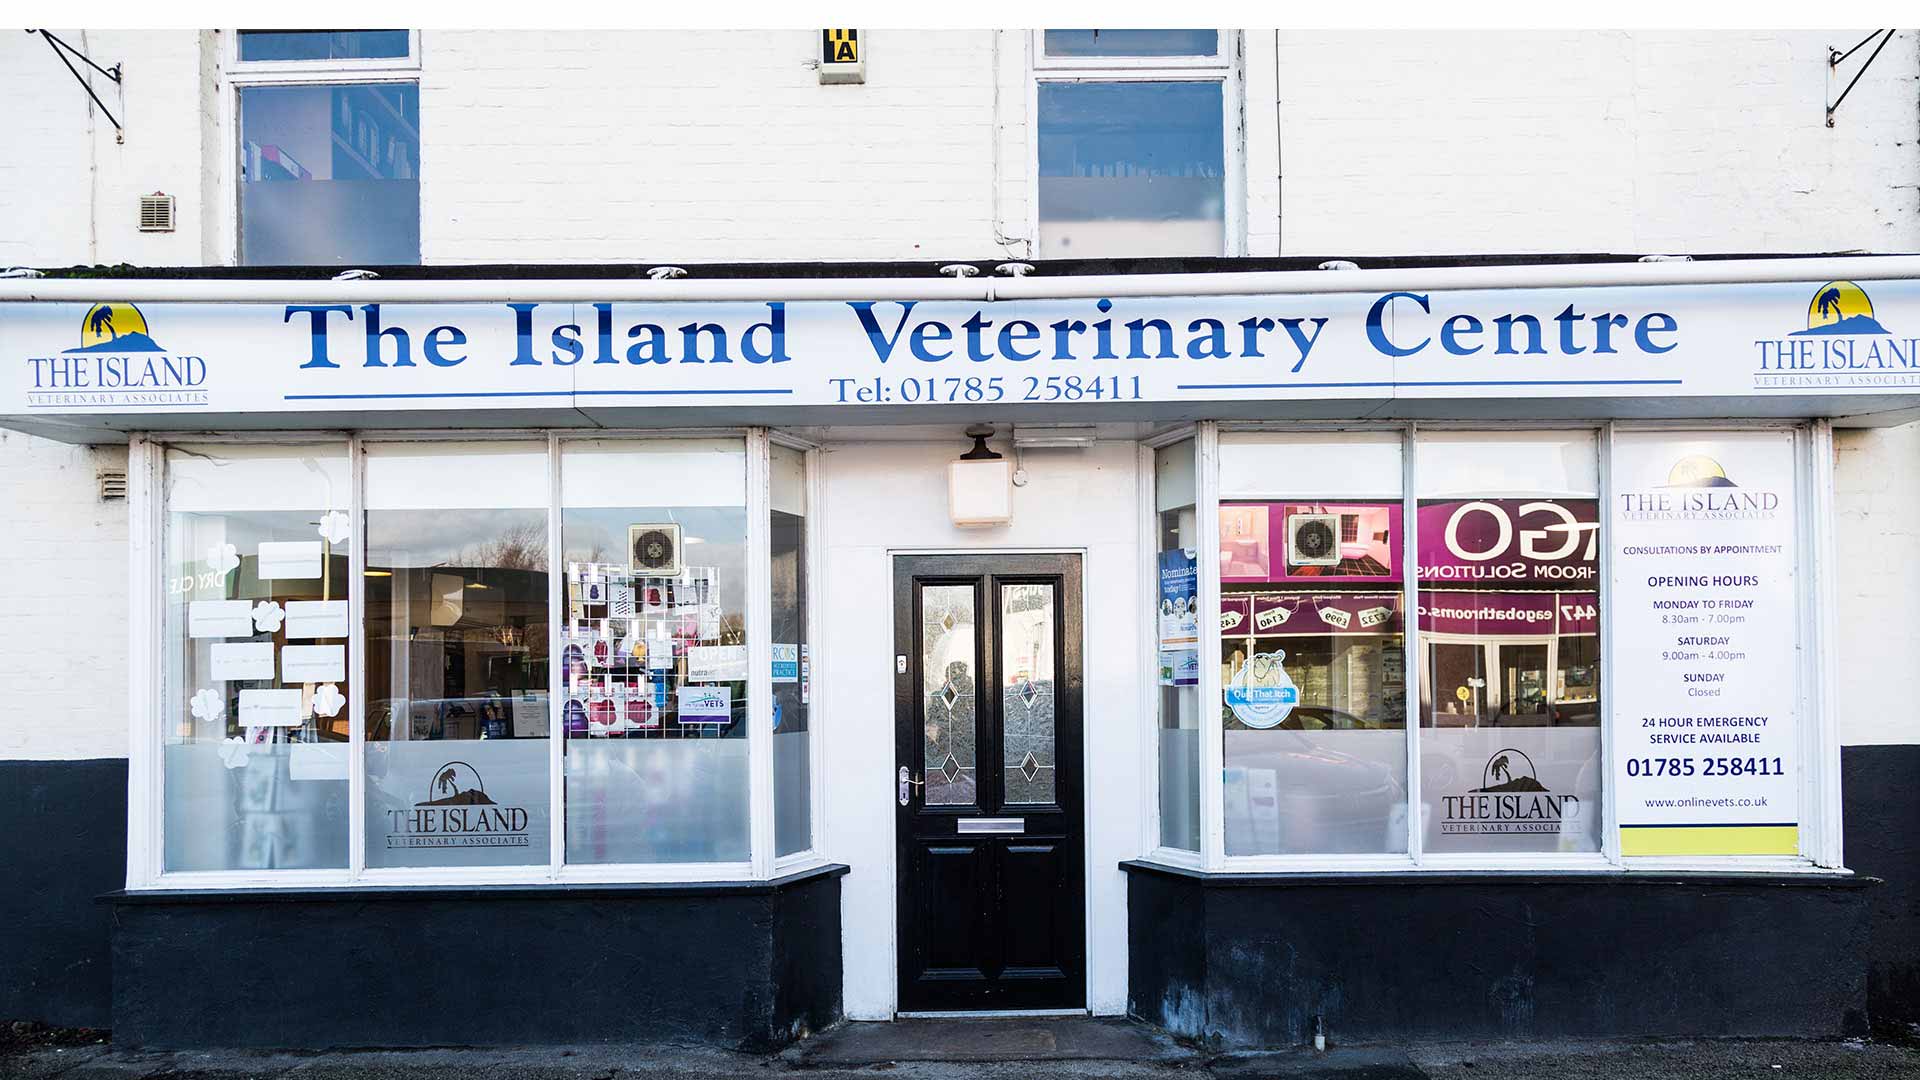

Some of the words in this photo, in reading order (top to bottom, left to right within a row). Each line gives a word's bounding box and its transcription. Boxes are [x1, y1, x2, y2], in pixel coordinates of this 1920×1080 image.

[284, 303, 468, 369] The
[506, 301, 792, 367] Island
[846, 298, 1329, 373] Veterinary
[1366, 292, 1679, 357] Centre
[1754, 340, 1816, 370] THE
[27, 358, 90, 388] THE
[96, 356, 207, 388] ISLAND
[1753, 376, 1841, 386] VETERINARY
[829, 378, 891, 403] Tel:
[900, 376, 1005, 402] 01785
[1023, 374, 1143, 400] 258411
[28, 394, 116, 405] VETERINARY
[124, 392, 209, 403] ASSOCIATES
[1621, 493, 1672, 512] THE
[1683, 492, 1779, 512] ISLAND
[1622, 512, 1697, 521] VETERINARY
[1704, 511, 1776, 520] ASSOCIATES
[1623, 546, 1699, 556] CONSULTATIONS
[1700, 546, 1712, 555] BY
[1714, 545, 1783, 555] APPOINTMENT
[1161, 565, 1198, 579] Nominate
[1648, 576, 1709, 588] OPENING
[1713, 575, 1759, 587] HOURS
[1653, 600, 1699, 609] MONDAY
[1702, 600, 1716, 609] TO
[1718, 600, 1754, 609] FRIDAY
[1662, 614, 1699, 624] 8.30am
[1708, 614, 1745, 625] 7.00pm
[1677, 636, 1730, 646] SATURDAY
[1662, 652, 1699, 661] 9.00am
[1708, 651, 1745, 662] 4.00pm
[1683, 674, 1725, 683] SUNDAY
[1688, 688, 1721, 697] Closed
[704, 700, 725, 708] VETS
[1642, 718, 1656, 728] 24
[1659, 718, 1693, 728] HOUR
[1696, 717, 1768, 728] EMERGENCY
[1650, 734, 1696, 744] SERVICE
[1699, 733, 1761, 744] AVAILABLE
[1626, 758, 1695, 777] 01785
[1702, 757, 1785, 776] 258411
[1442, 796, 1490, 820] THE
[1495, 794, 1581, 820] ISLAND
[1645, 796, 1768, 808] www.onlinevets.co.uk
[387, 809, 437, 833] THE
[442, 807, 528, 833] ISLAND
[1442, 824, 1511, 832] VETERINARY
[387, 838, 457, 846] VETERINARY
[463, 836, 529, 845] ASSOCIATES
